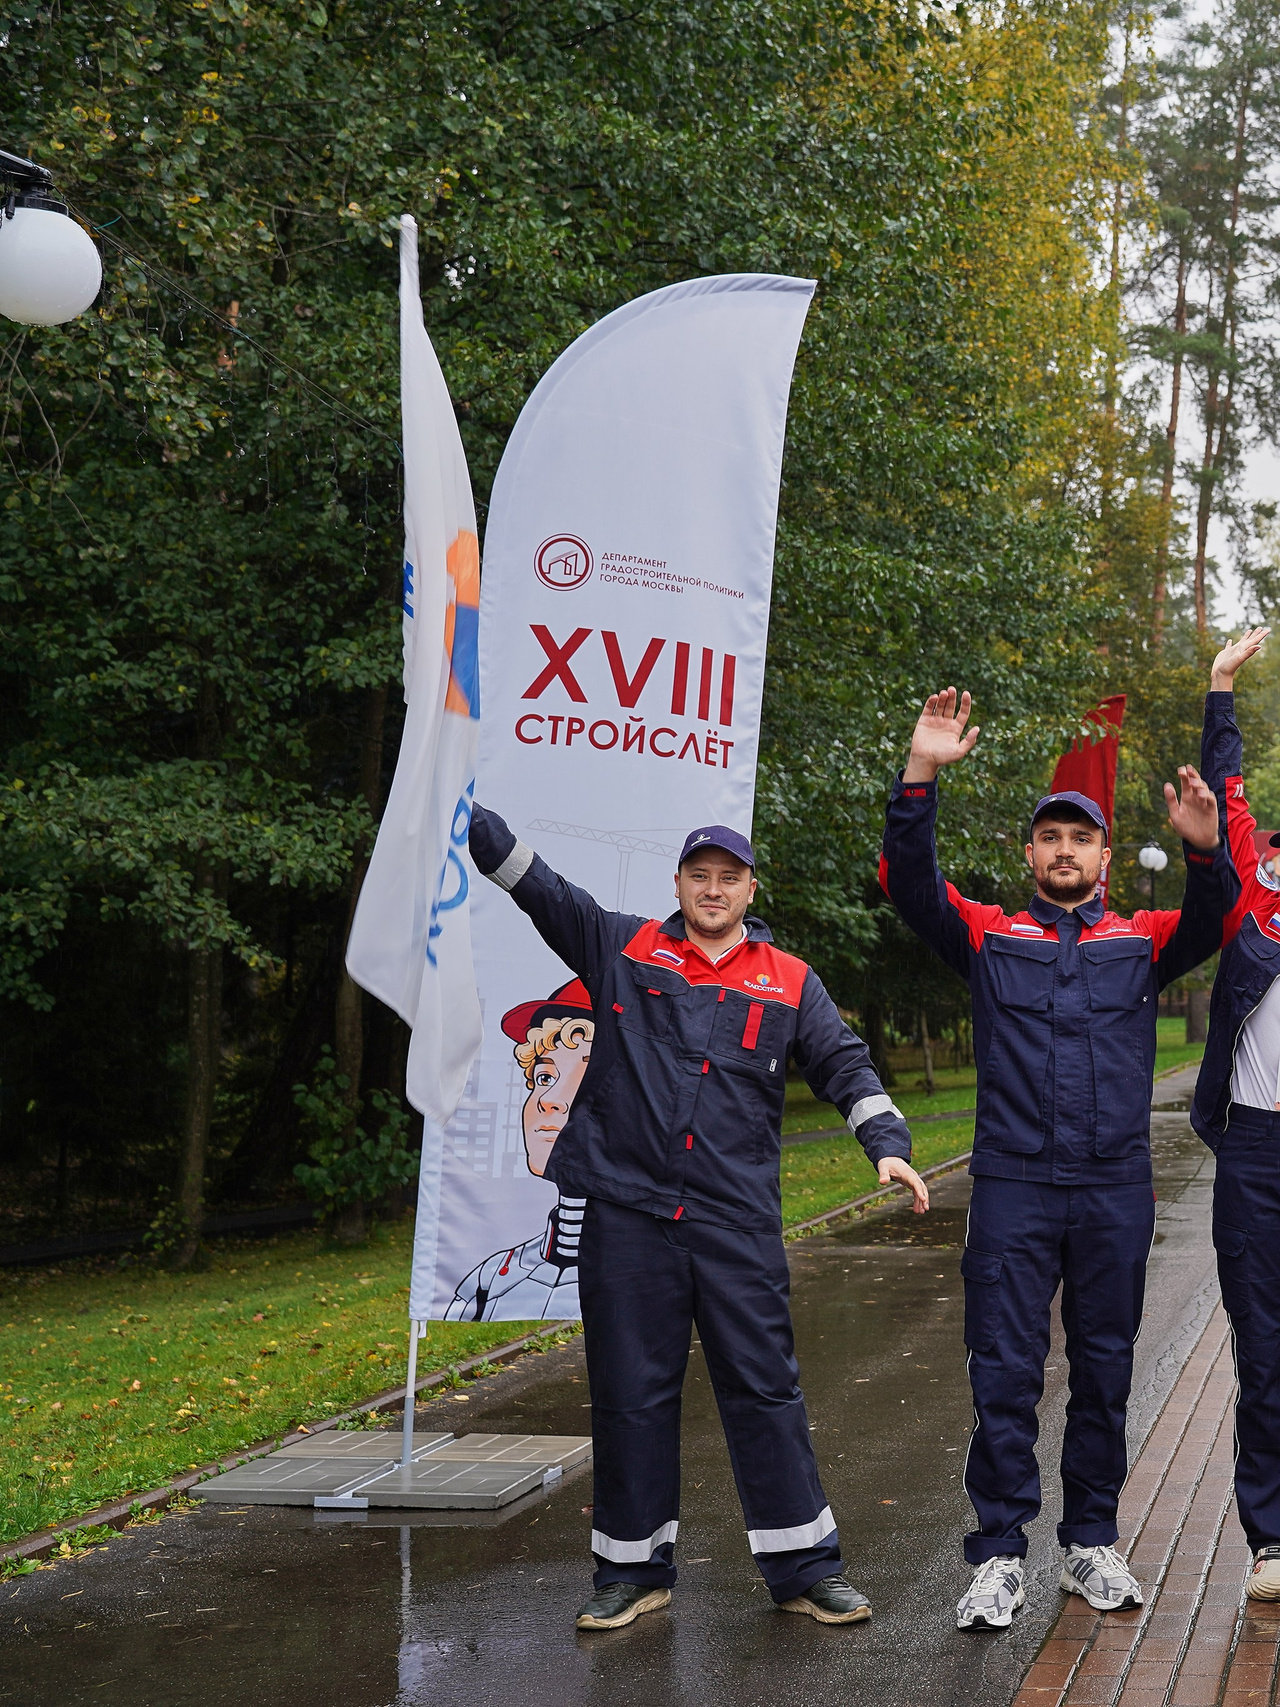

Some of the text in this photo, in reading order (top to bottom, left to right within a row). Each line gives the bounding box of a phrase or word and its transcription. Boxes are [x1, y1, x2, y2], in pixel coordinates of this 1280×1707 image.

[601, 552, 667, 569] ДЕПАРТАМЕНТ
[600, 563, 744, 599] ГРАДОСТРОИТЕЛЬНОЙ ПОЛИТИКИ
[600, 574, 684, 593] ГОРОДА МОСКВЫ
[521, 624, 736, 727] XVIII
[515, 713, 735, 769] СТРОЙСЛЁТ
